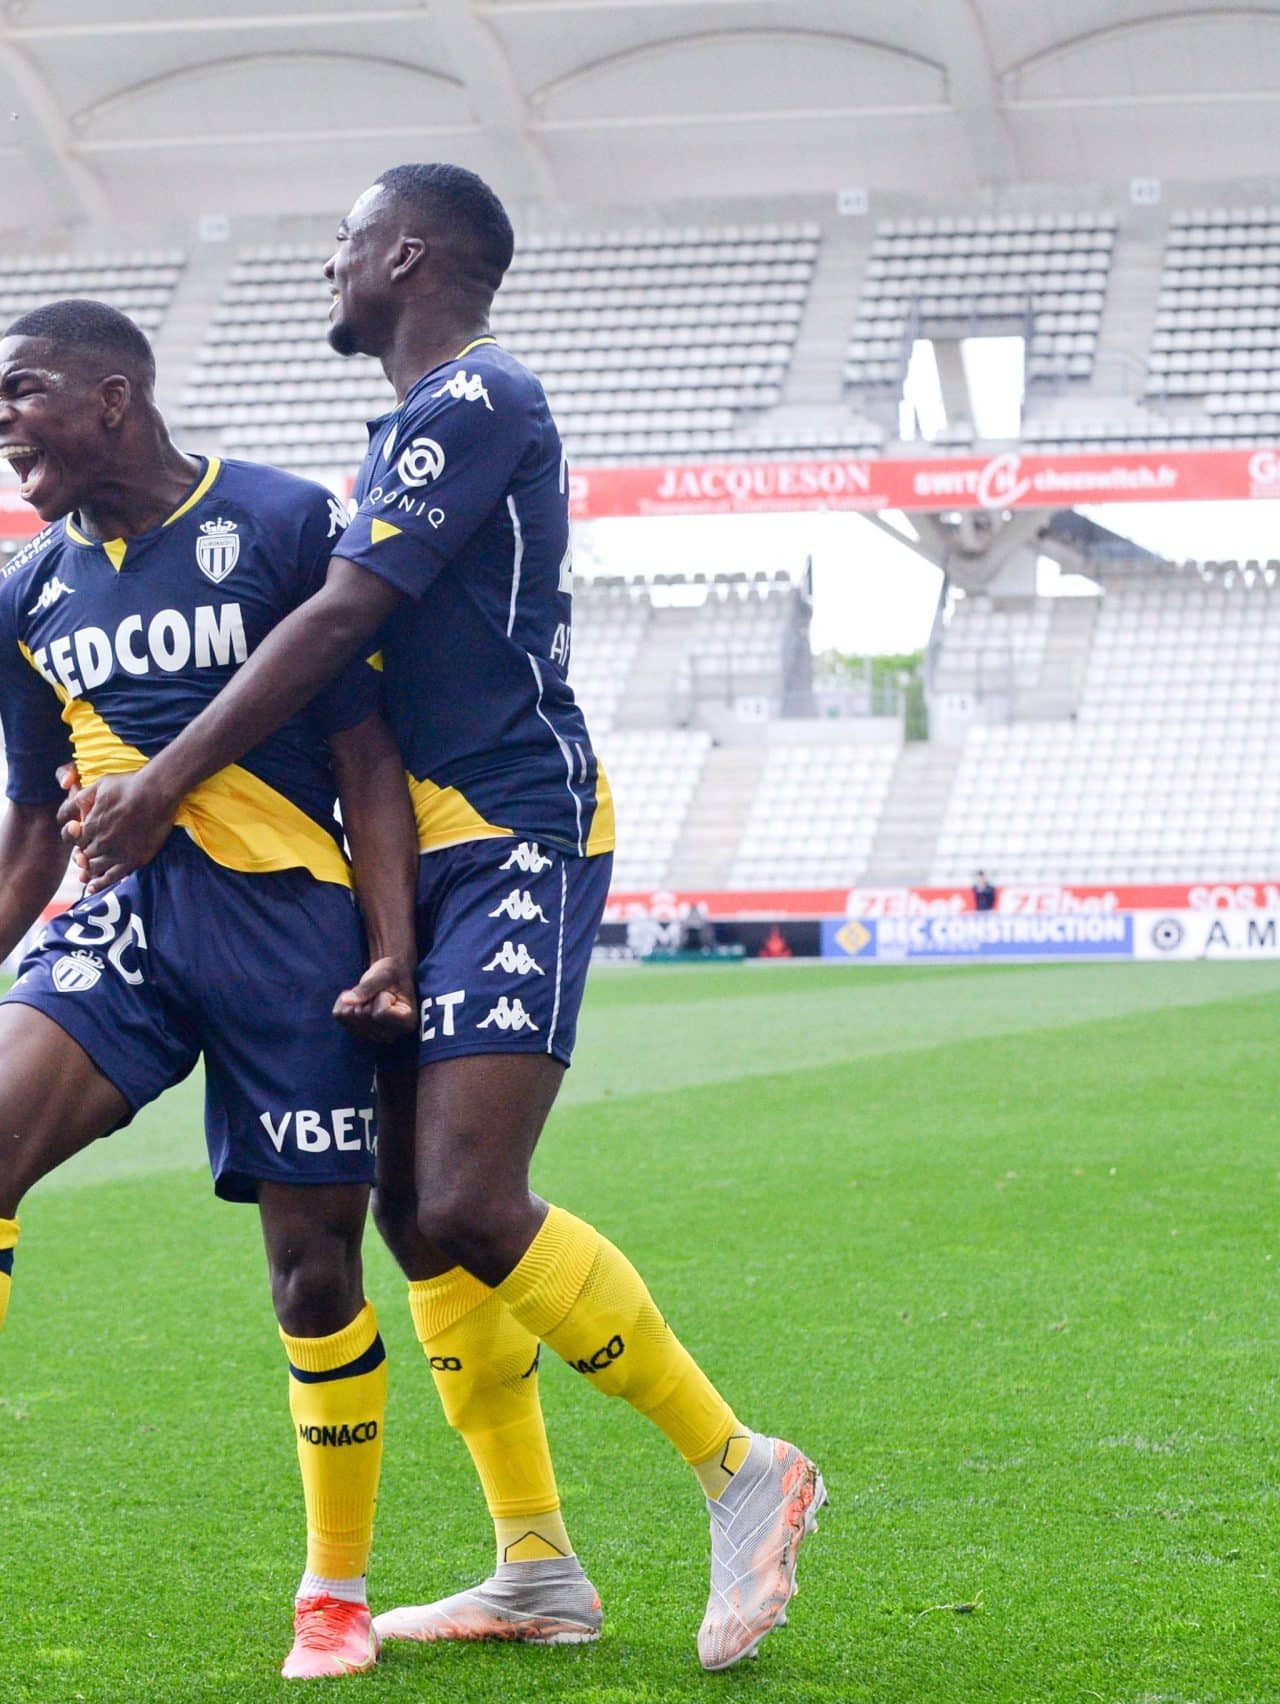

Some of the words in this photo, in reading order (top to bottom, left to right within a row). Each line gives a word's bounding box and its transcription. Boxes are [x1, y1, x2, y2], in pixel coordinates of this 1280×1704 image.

[657, 462, 870, 500] JACQUESON
[32, 602, 248, 698] FEDCOM
[421, 989, 465, 1042] ET
[259, 1107, 374, 1153] VBET
[299, 1420, 377, 1447] MONACO
